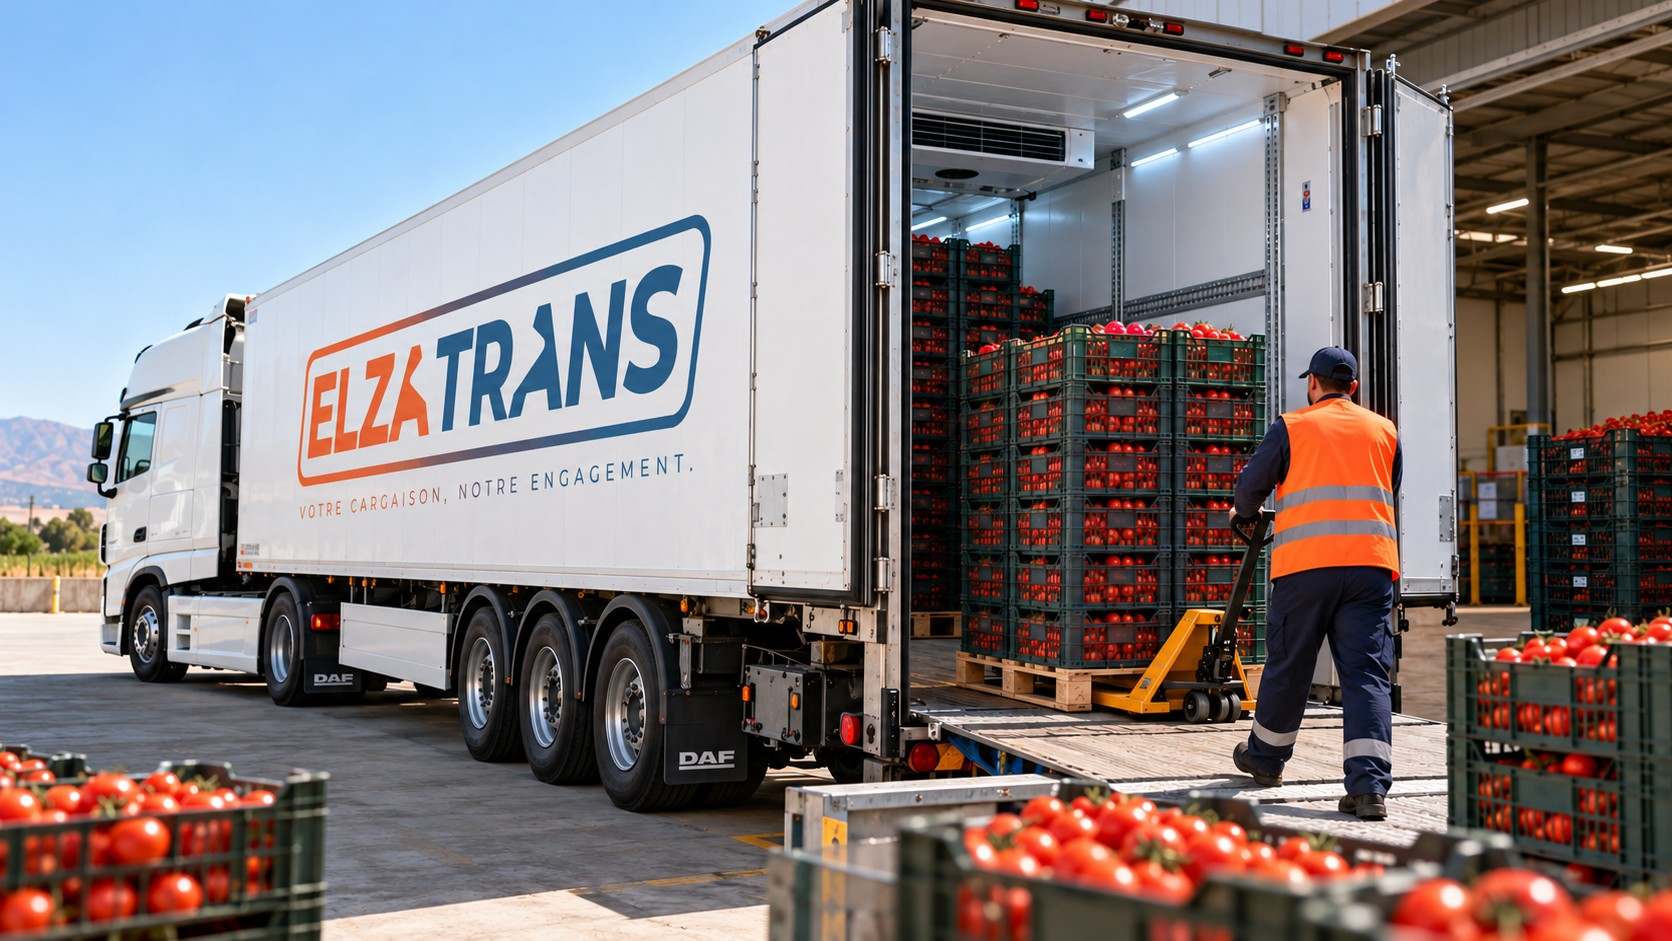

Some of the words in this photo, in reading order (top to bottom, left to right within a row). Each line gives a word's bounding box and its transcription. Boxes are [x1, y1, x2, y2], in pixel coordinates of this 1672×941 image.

[299, 501, 342, 520] VOTRE
[351, 487, 447, 514] CARGAISON,
[458, 476, 519, 500] NOTRE
[531, 454, 694, 492] ENGAGEMENT.
[313, 673, 354, 683] DAF
[679, 750, 735, 766] DAF
